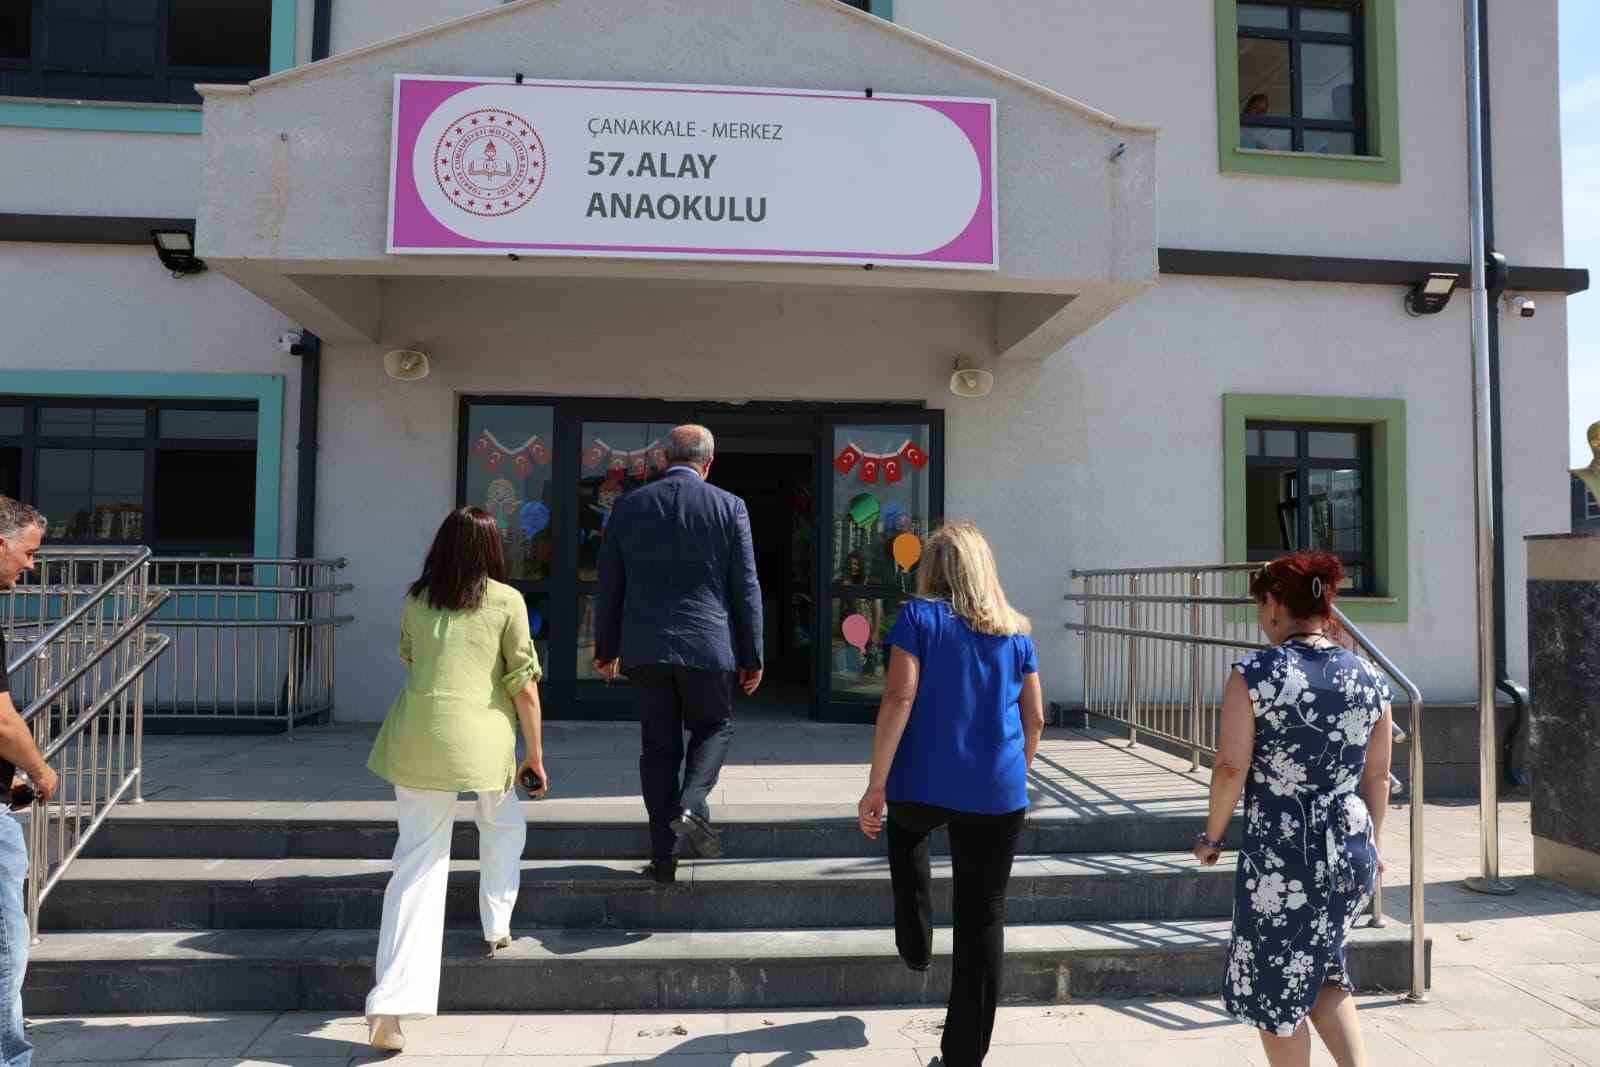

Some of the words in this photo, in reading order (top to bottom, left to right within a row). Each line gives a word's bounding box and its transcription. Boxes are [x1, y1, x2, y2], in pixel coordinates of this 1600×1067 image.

[587, 118, 697, 138] ÇANAKKALE
[712, 122, 783, 140] MERKEZ
[587, 151, 718, 179] 57.ALAY
[586, 192, 767, 222] ANAOKULU
